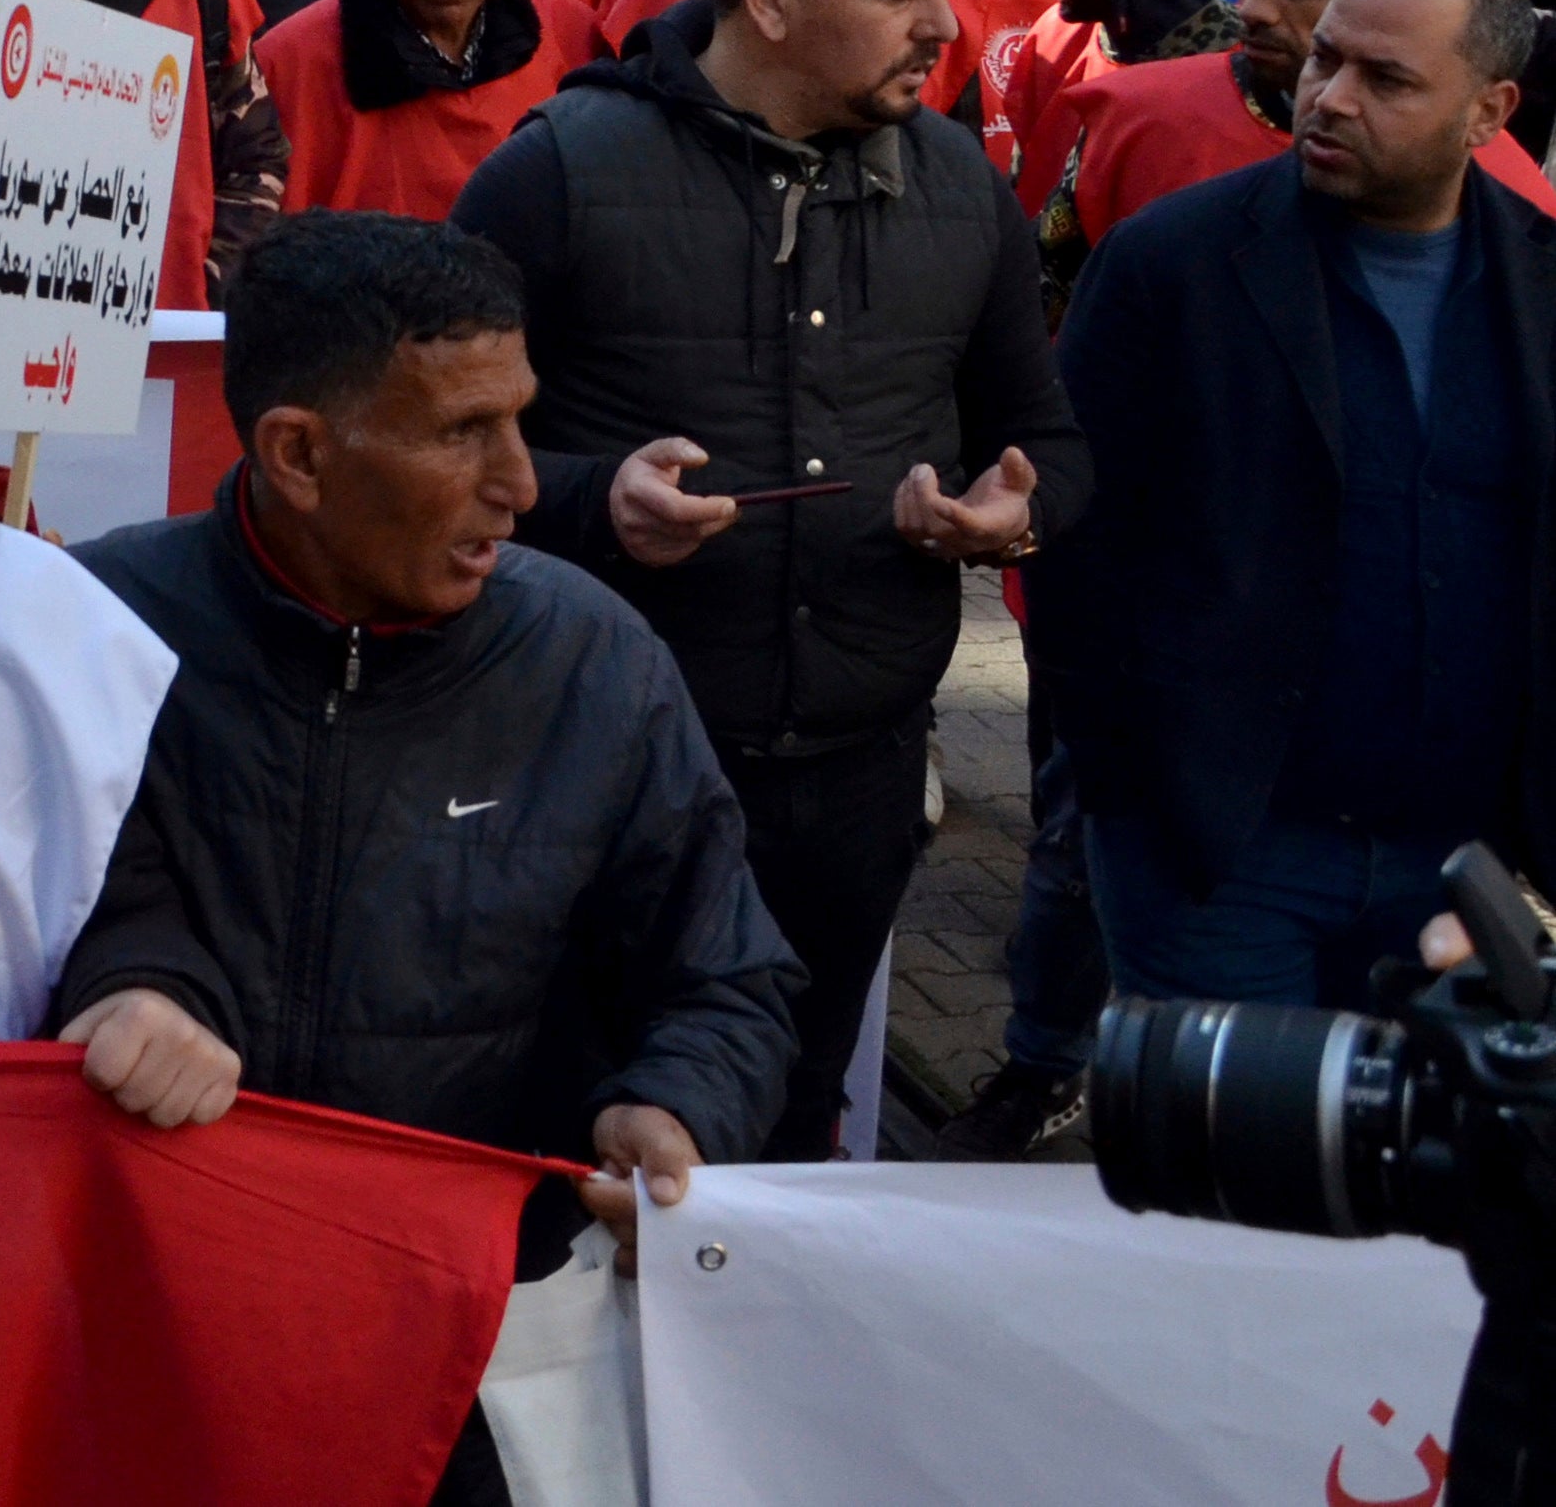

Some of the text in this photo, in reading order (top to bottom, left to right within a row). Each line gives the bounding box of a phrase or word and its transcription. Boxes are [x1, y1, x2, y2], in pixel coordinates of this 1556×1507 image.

[43, 160, 70, 227] عن
[66, 157, 126, 231] الحصار
[121, 169, 151, 243] رفع
[35, 241, 104, 310] العلاقات
[22, 331, 78, 405] واجب
